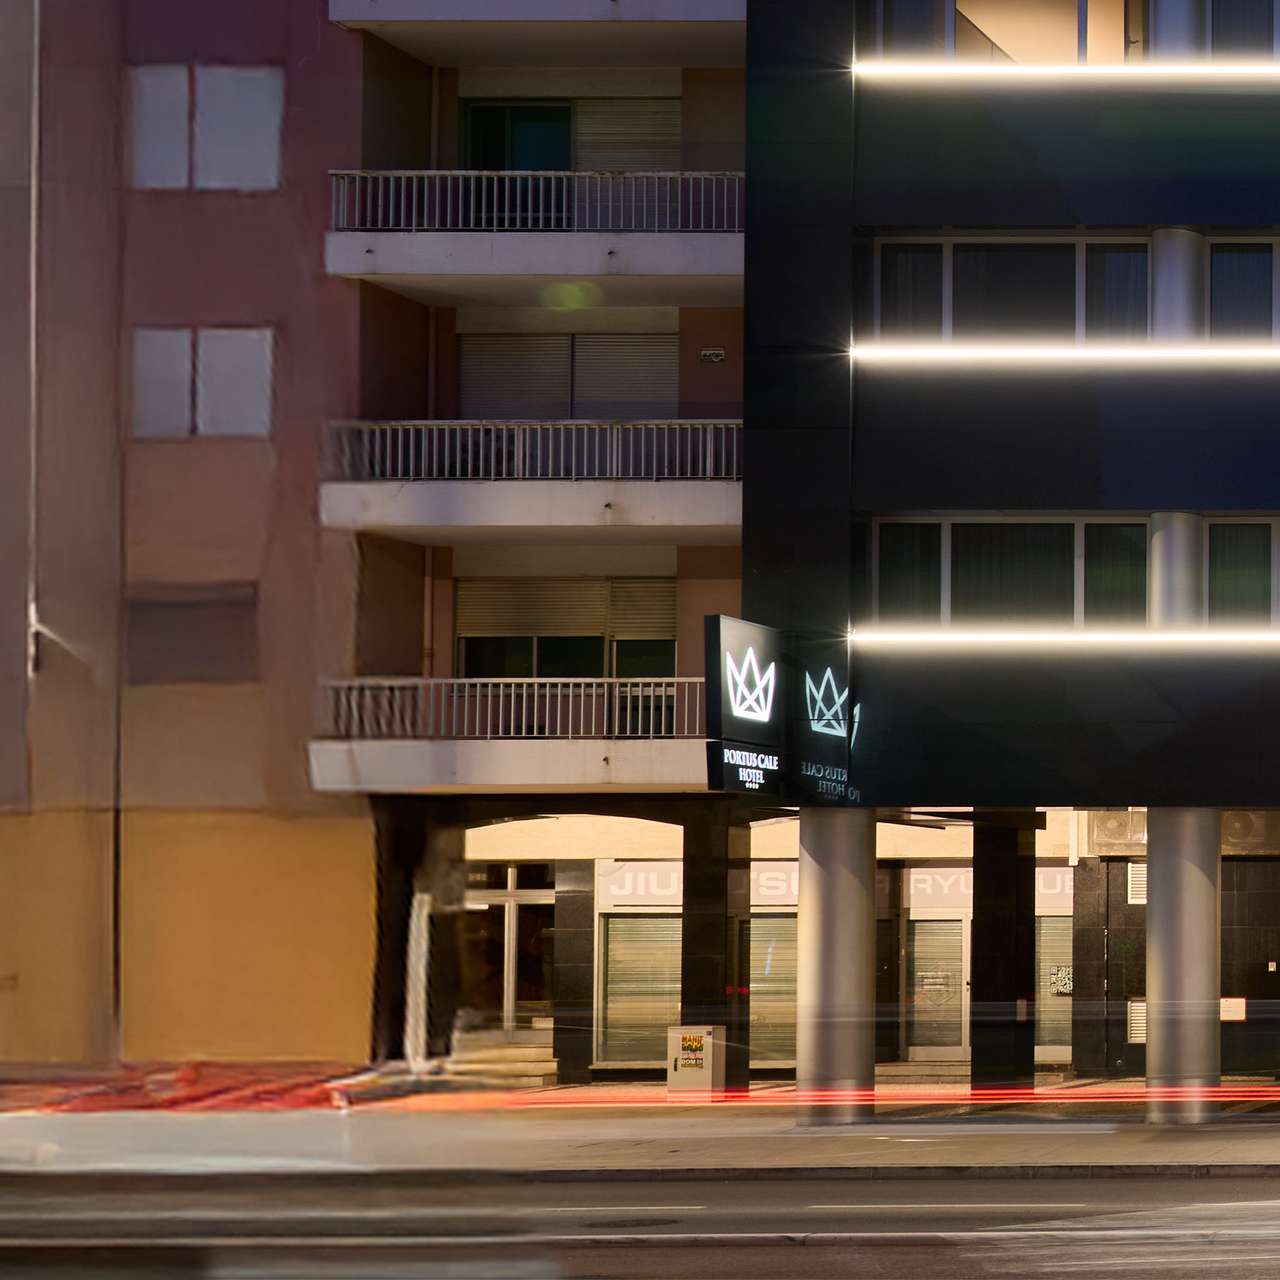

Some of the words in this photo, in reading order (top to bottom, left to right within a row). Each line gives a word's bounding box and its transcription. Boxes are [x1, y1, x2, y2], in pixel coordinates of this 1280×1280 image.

[723, 749, 757, 767] PORTUS
[757, 753, 778, 770] CALE
[738, 767, 765, 784] HOTEL
[609, 871, 680, 896] JIU
